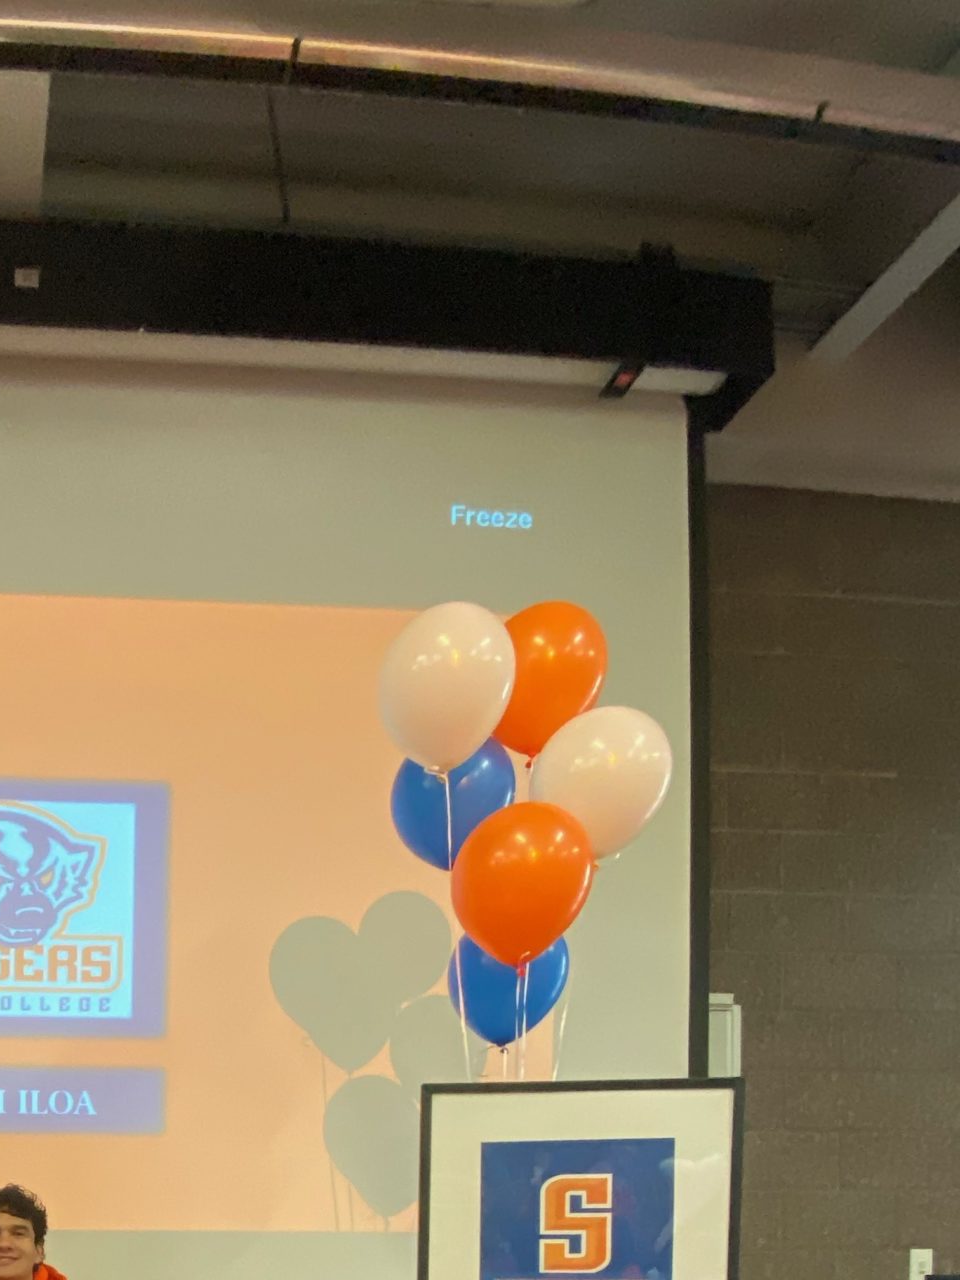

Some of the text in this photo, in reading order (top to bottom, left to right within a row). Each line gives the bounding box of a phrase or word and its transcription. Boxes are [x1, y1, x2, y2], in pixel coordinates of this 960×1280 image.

[451, 504, 533, 529] Freeze
[19, 1090, 97, 1116] ILOA
[539, 1173, 614, 1274] S
